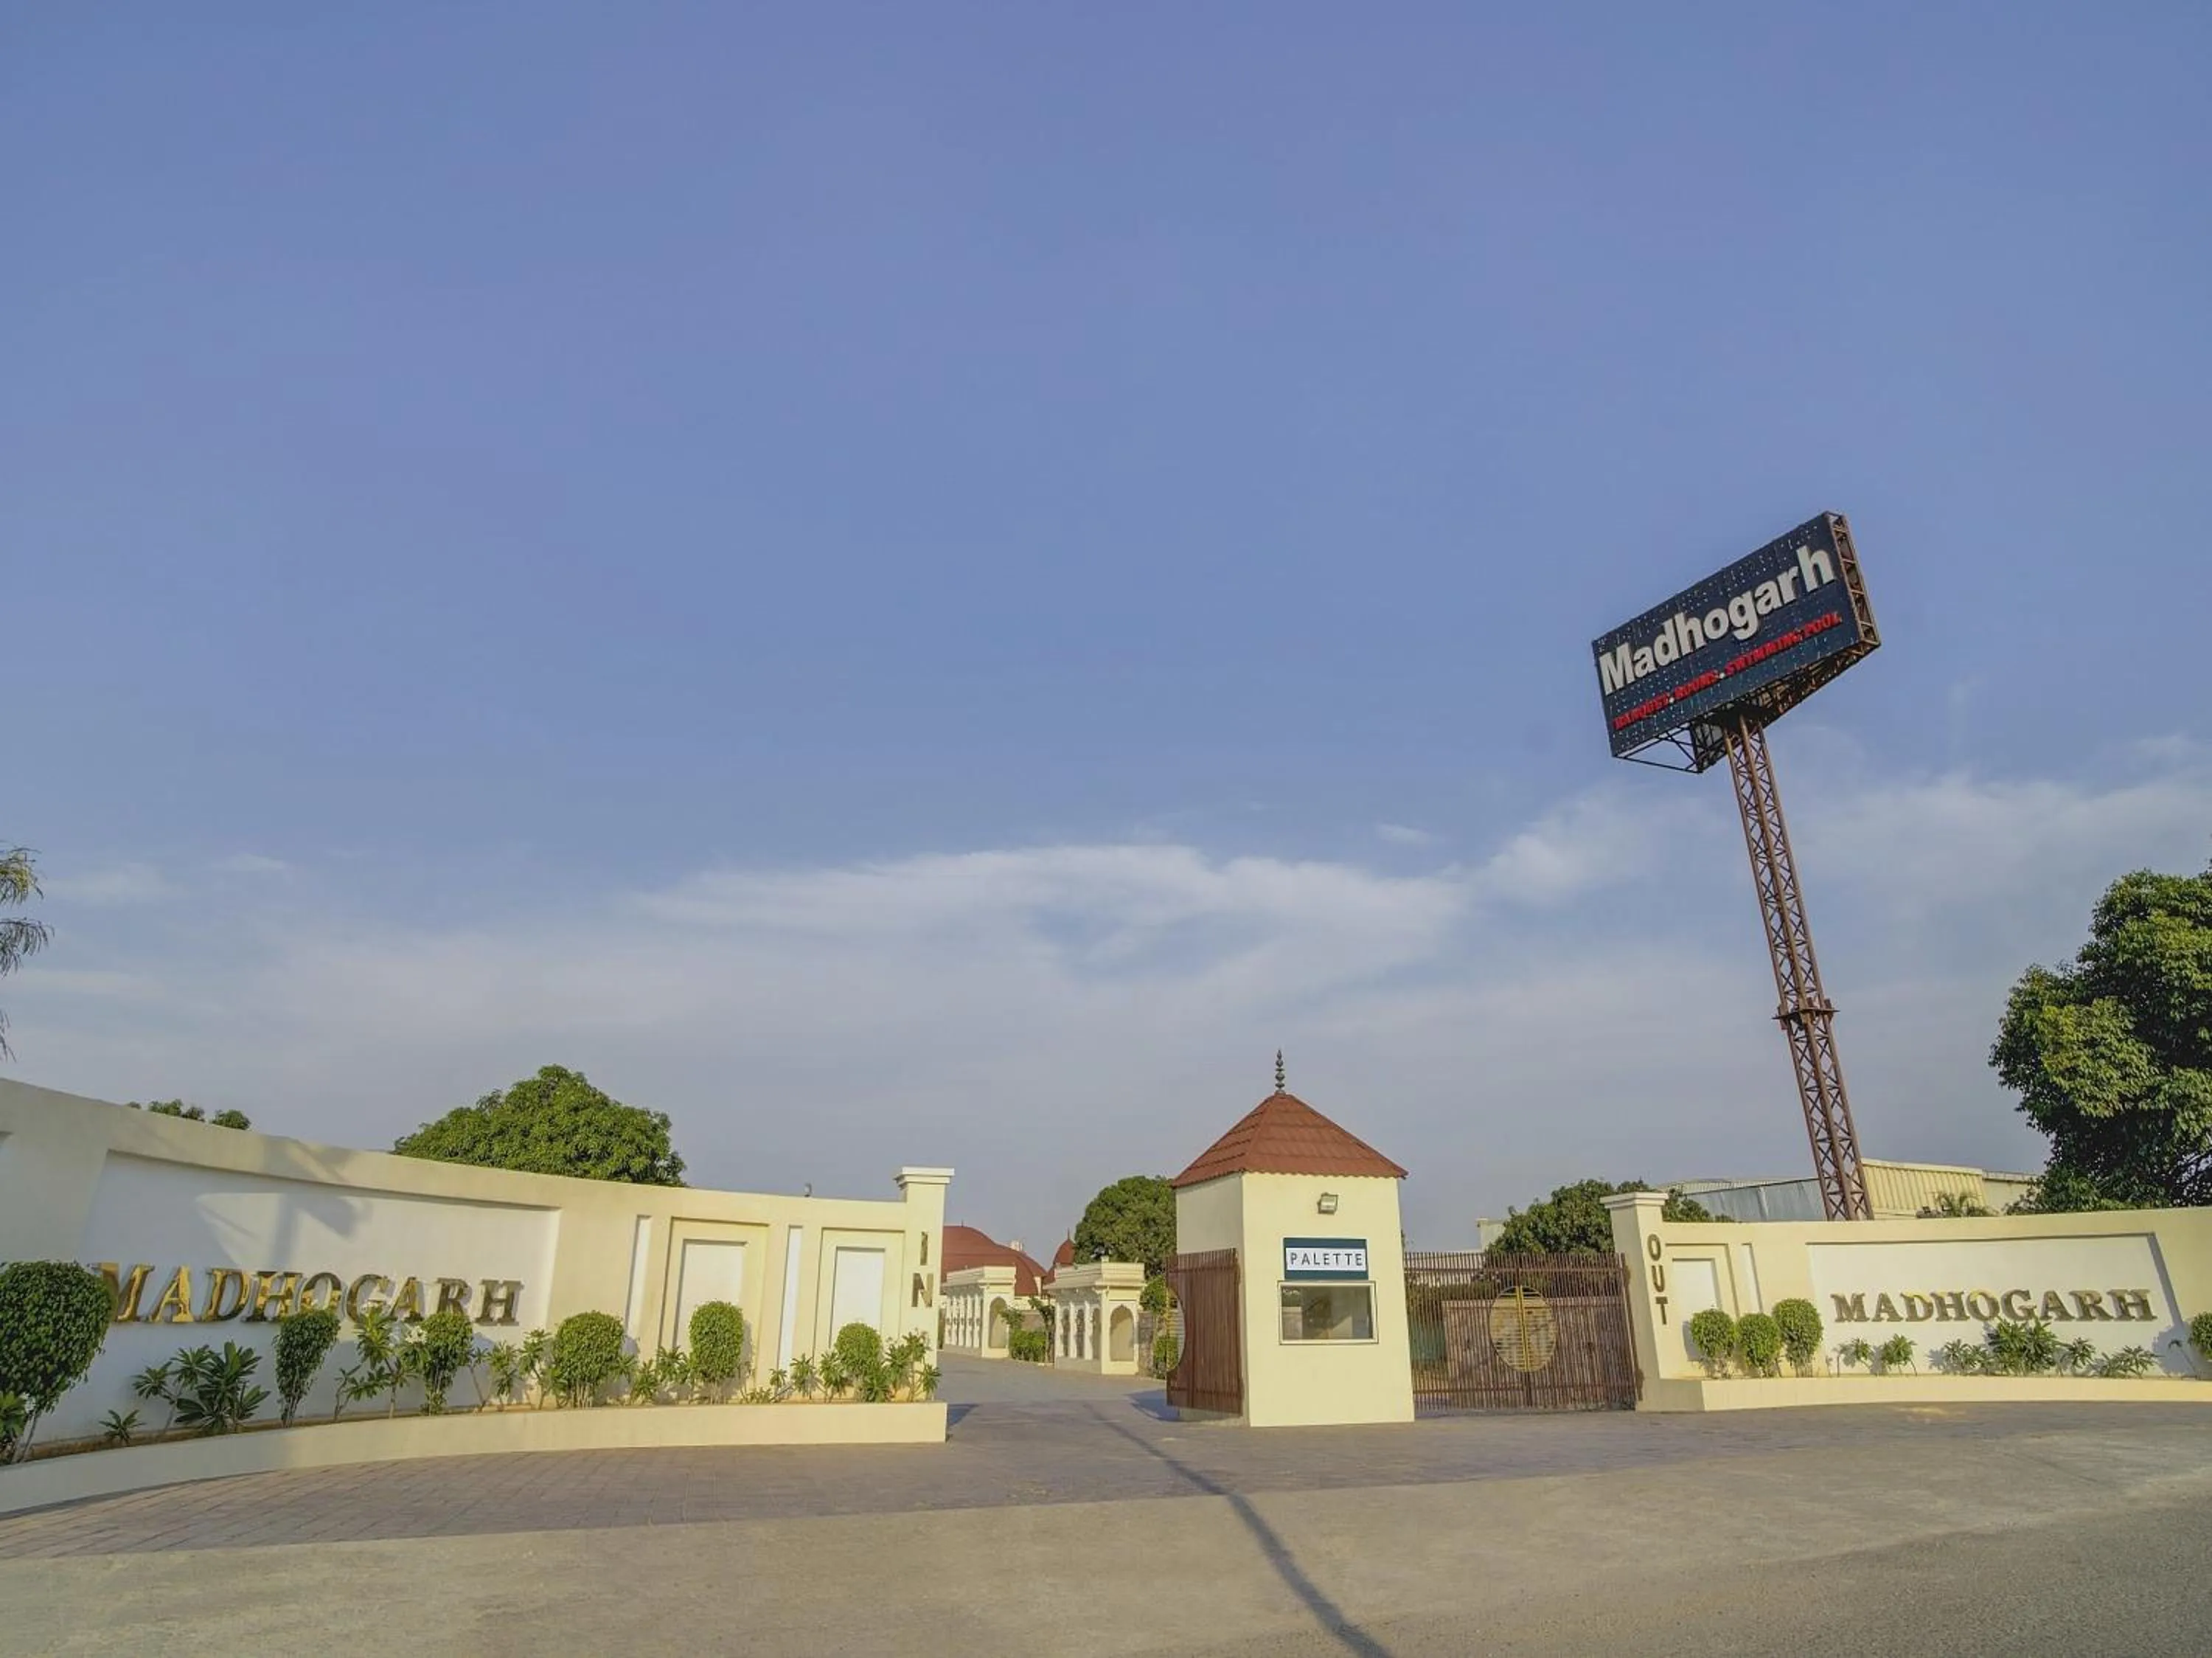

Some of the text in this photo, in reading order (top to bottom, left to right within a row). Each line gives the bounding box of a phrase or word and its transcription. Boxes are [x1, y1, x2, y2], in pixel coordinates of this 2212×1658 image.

[1599, 545, 1835, 696] Madhogarh
[1725, 629, 1803, 676] SWIMMING
[1804, 611, 1843, 638] POOL
[911, 1231, 934, 1307] IN
[1290, 1252, 1363, 1266] PALETTE
[1647, 1234, 1669, 1325] OUT
[91, 1262, 524, 1326] MADHOGARH
[1830, 1288, 2157, 1323] MADHOGARH
